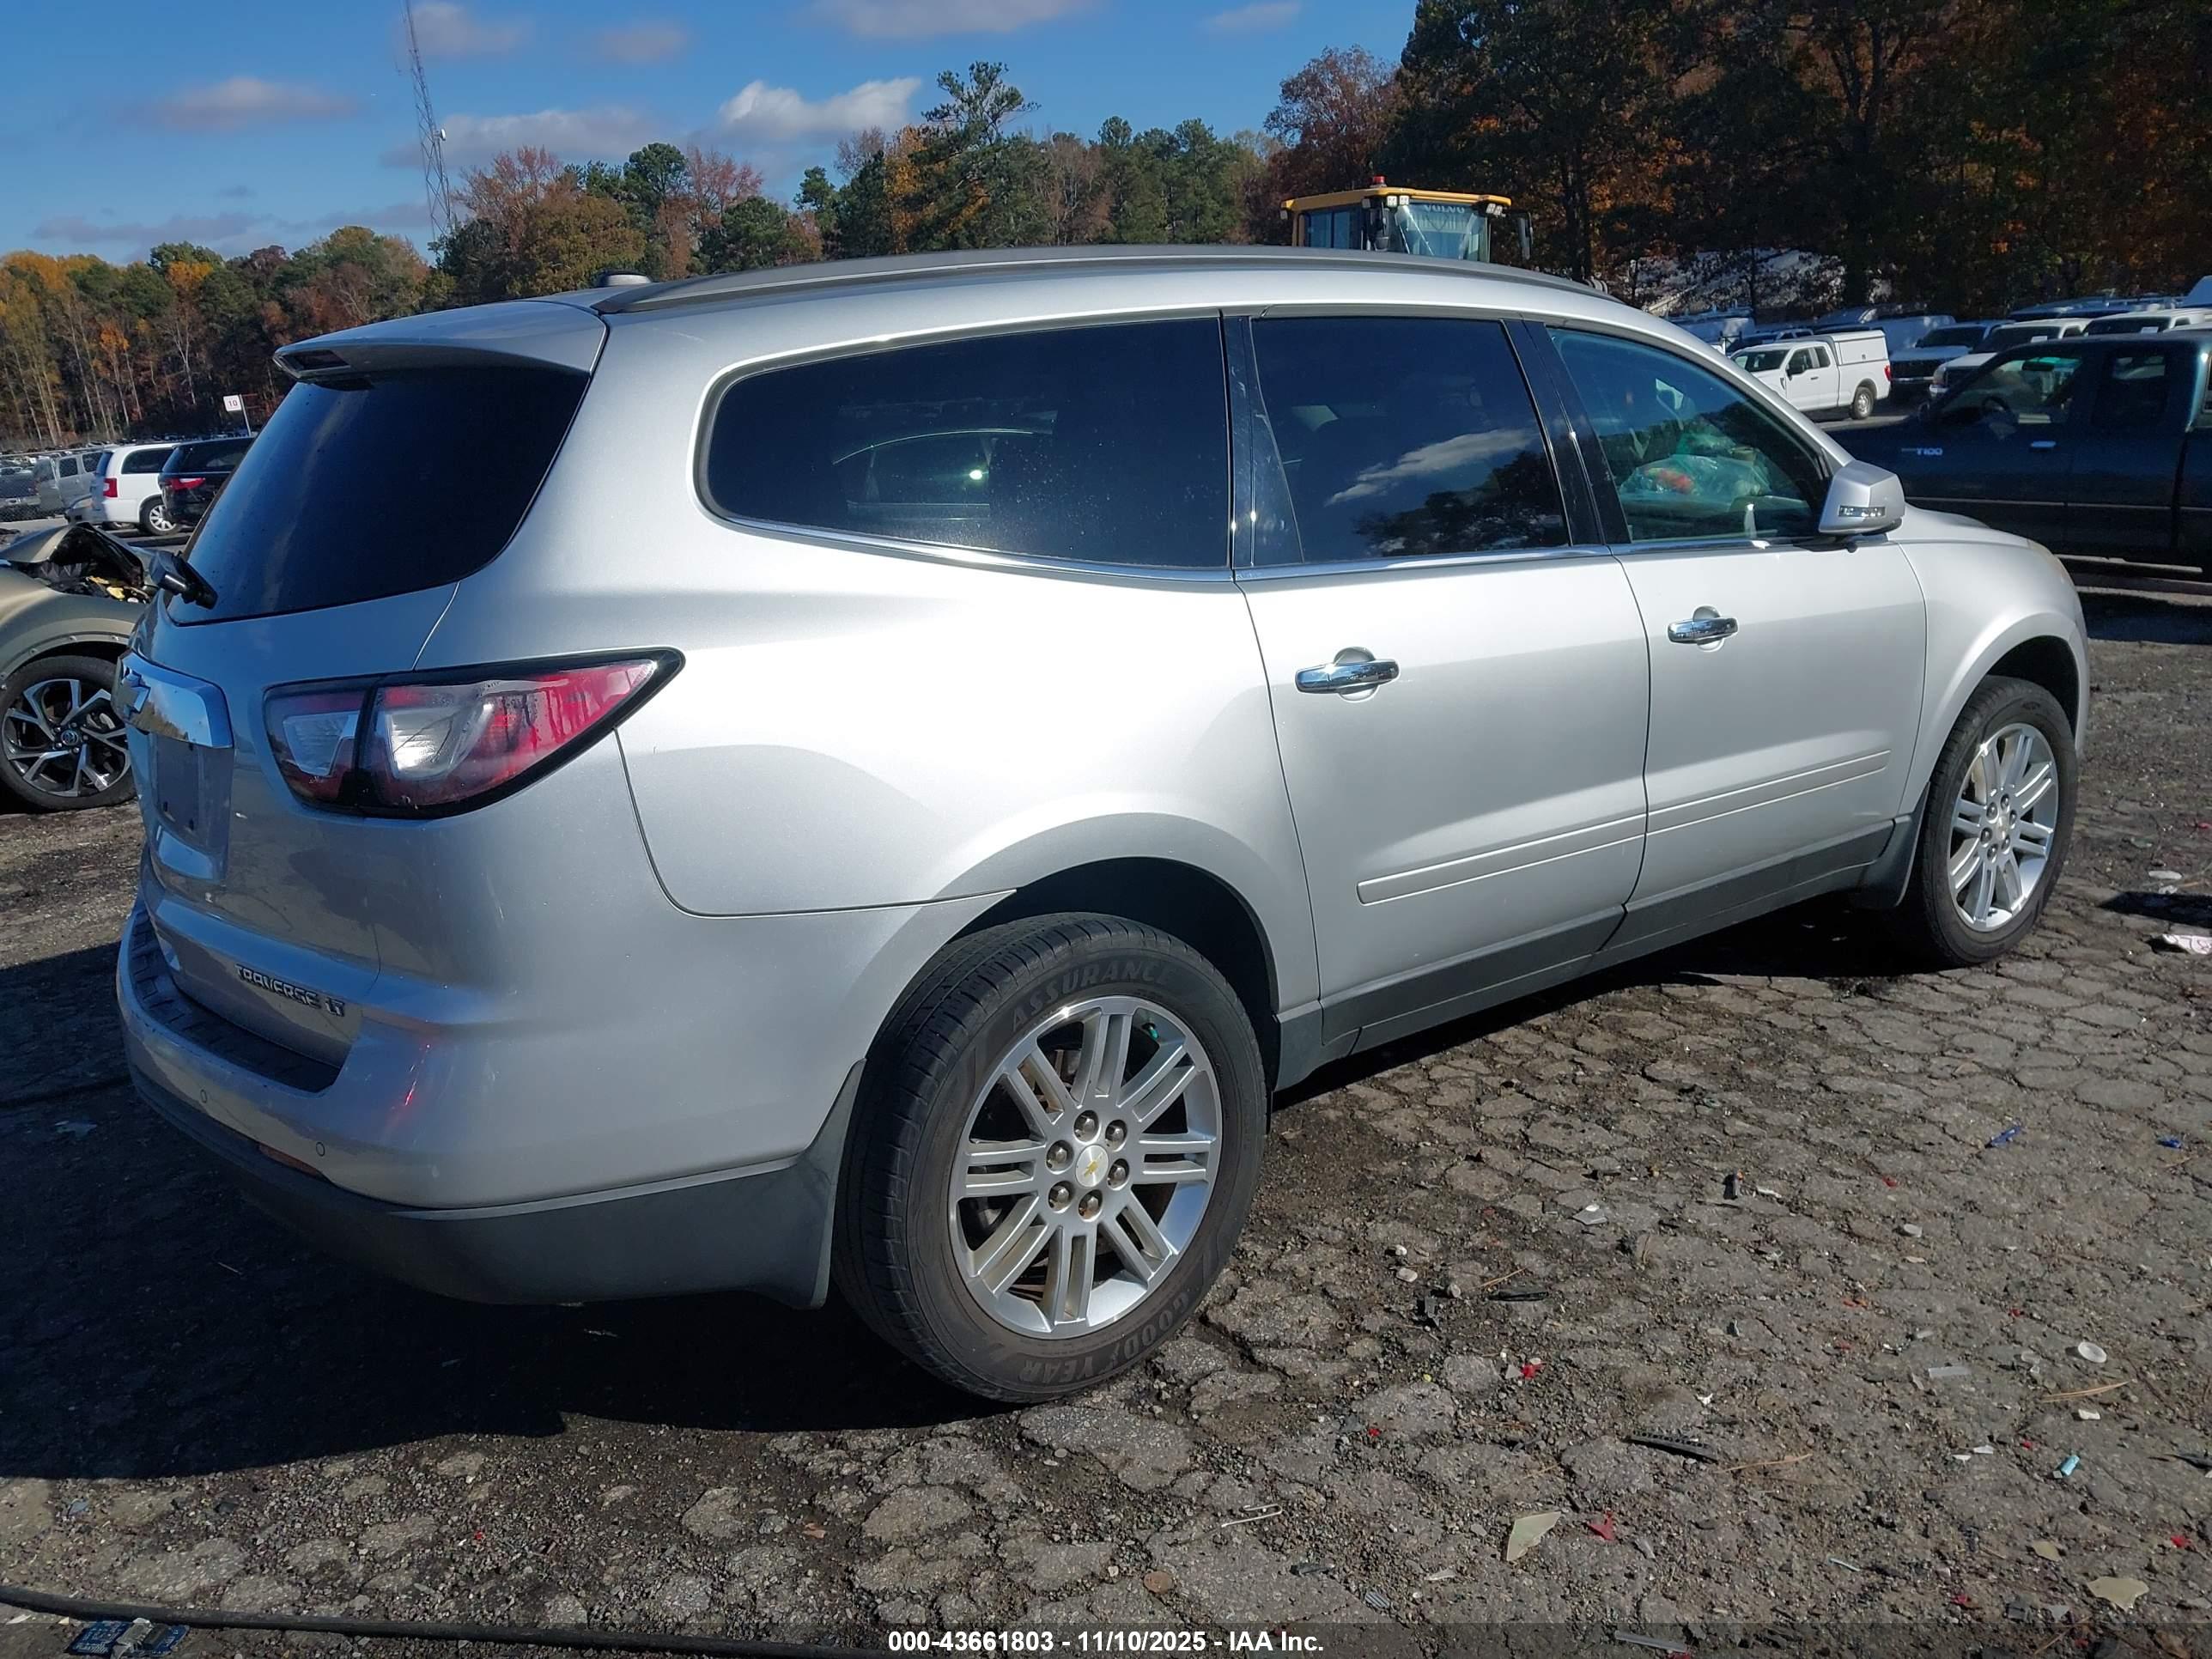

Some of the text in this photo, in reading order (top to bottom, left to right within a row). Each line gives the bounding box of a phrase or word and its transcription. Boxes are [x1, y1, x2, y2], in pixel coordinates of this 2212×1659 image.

[234, 963, 344, 1017] TRAVERSE LT
[1012, 959, 1174, 1031] ASSURANCE
